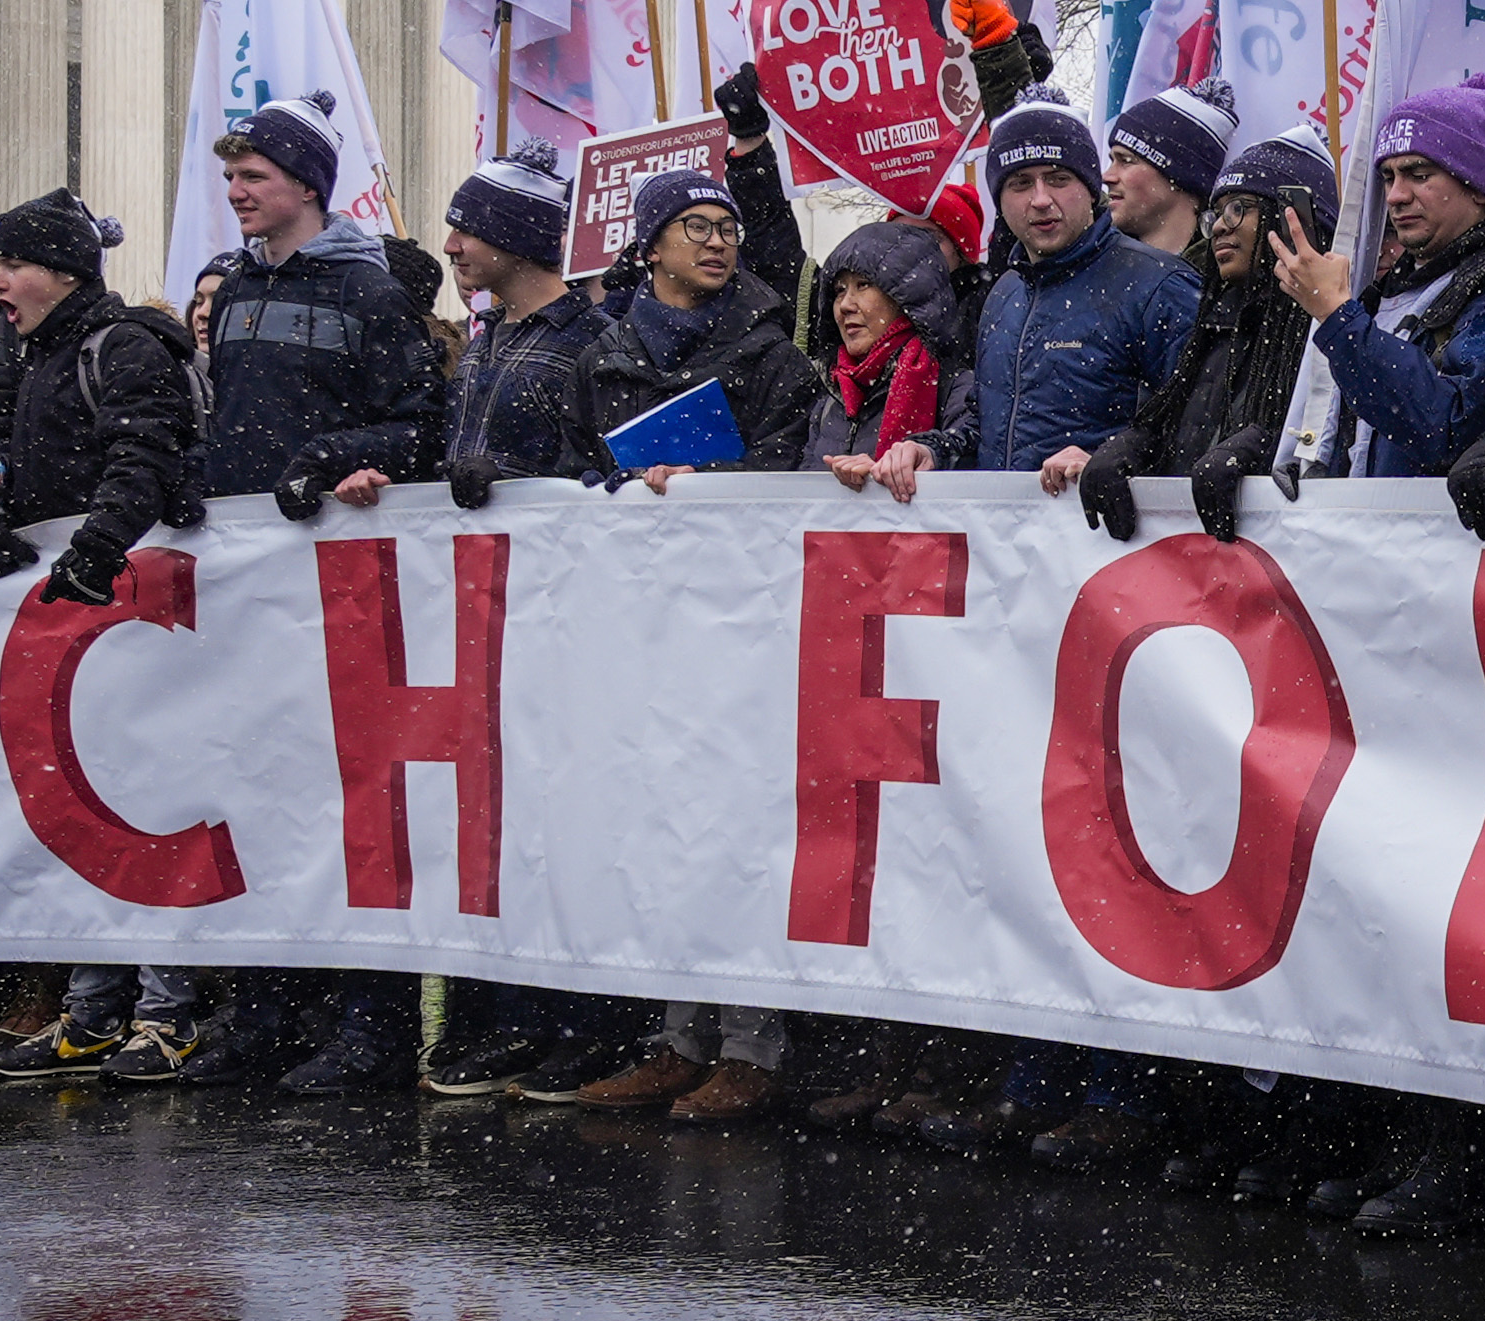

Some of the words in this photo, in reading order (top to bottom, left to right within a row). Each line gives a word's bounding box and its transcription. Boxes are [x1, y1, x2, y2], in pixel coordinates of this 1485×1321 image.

[815, 16, 903, 58] them
[786, 38, 925, 111] BOTH
[857, 129, 890, 155] LIVE
[892, 120, 937, 147] ACTION
[1009, 148, 1025, 163] ARE
[1025, 146, 1063, 160] PRO-LIFE
[1133, 140, 1167, 168] PRO-LIFE
[596, 159, 637, 189] LET
[644, 145, 710, 173] THEIR
[1051, 340, 1082, 349] Columbia
